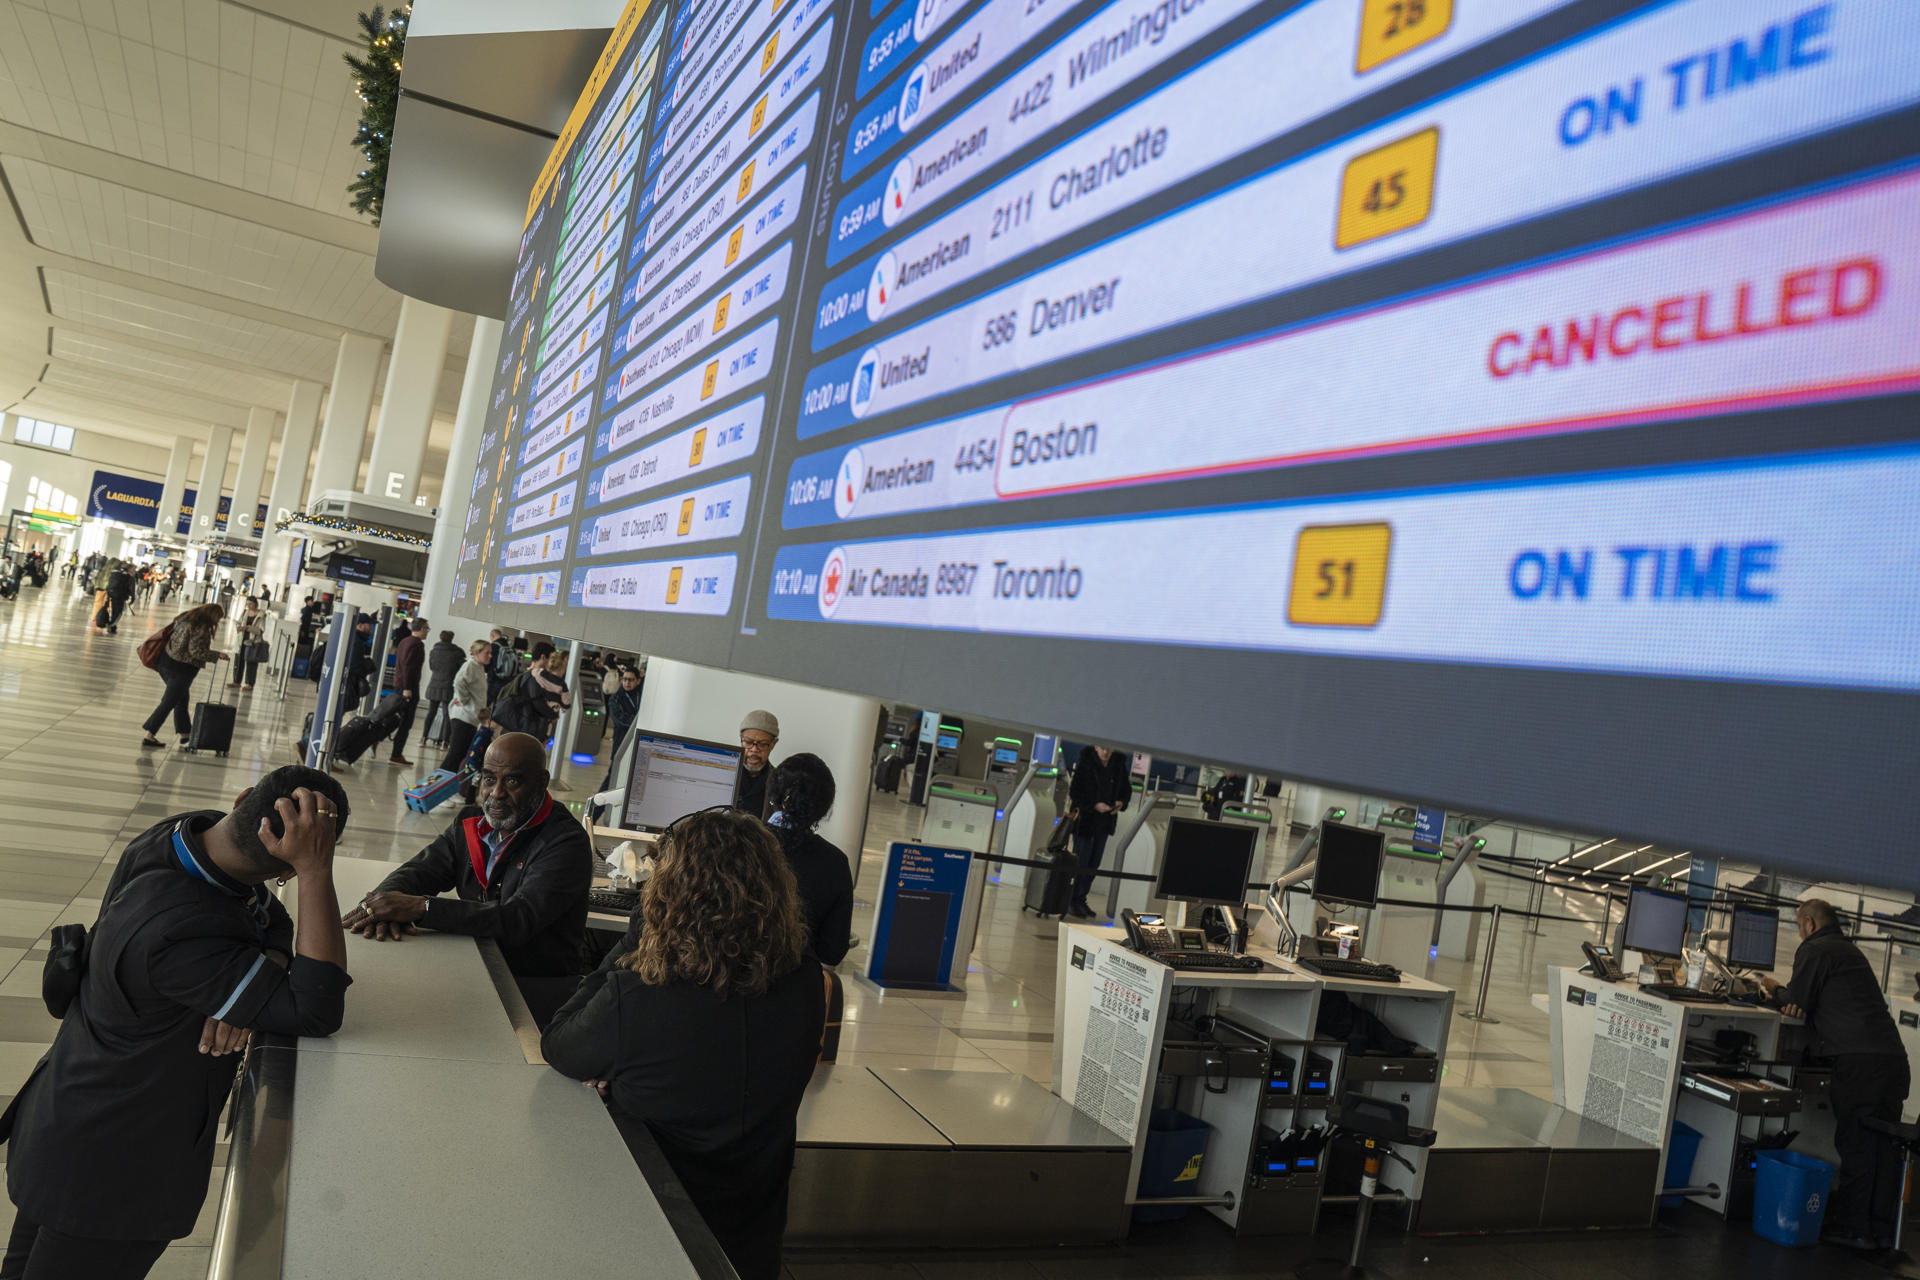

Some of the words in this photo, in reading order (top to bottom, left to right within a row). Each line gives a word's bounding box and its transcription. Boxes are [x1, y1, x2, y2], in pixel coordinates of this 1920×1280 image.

[838, 204, 864, 241] 9:59
[864, 197, 881, 226] AM
[912, 125, 988, 193] American
[1008, 73, 1054, 124] 4422
[1068, 0, 1200, 89] Wilmingto
[853, 116, 880, 155] 9:55
[878, 105, 897, 135] AM
[928, 32, 982, 94] United
[652, 201, 675, 236] American
[691, 161, 711, 196] Dallas
[709, 137, 732, 179] (DFW)
[779, 73, 792, 101] ON
[791, 52, 811, 88] TIME
[661, 149, 685, 188] American
[710, 95, 729, 130] Louis
[643, 255, 665, 286] American
[680, 213, 706, 255] Chicago
[704, 193, 726, 231] (ORD)
[767, 144, 780, 170] ON
[778, 125, 798, 159] TIME
[804, 384, 834, 417] 10:00
[832, 382, 850, 405] AM
[880, 345, 930, 389] United
[1029, 278, 1121, 337] Denver
[1360, 171, 1410, 216] 45
[1558, 79, 1644, 149] ON
[1663, 3, 1836, 111] TIME
[818, 296, 850, 330] 10:00
[848, 288, 865, 313] AM
[896, 233, 971, 290] American
[990, 190, 1034, 241] 2111
[1048, 126, 1169, 210] Charlotte
[634, 308, 655, 336] American
[670, 266, 702, 307] Charleston
[754, 214, 766, 237] ON
[766, 197, 785, 227] TIME
[624, 360, 647, 388] Southwest
[659, 332, 684, 368] Chicago
[682, 317, 705, 352] (MDW)
[741, 286, 754, 308] ON
[753, 272, 771, 300] TIME
[615, 416, 635, 439] American
[650, 391, 675, 420] Nashville
[728, 356, 741, 378] ON
[740, 346, 758, 372] TIME
[789, 476, 818, 506] 10:06
[816, 478, 834, 500] AM
[862, 457, 934, 494] American
[954, 438, 996, 474] 4454
[1010, 422, 1098, 468] Boston
[1486, 255, 1883, 381] CANCELLED
[106, 490, 154, 508] LAGUARDIA
[385, 472, 405, 498] E
[606, 470, 626, 490] American
[639, 455, 658, 478] Detroit
[716, 429, 728, 448] ON
[727, 421, 745, 444] TIME
[164, 516, 174, 526] A
[200, 515, 209, 526] B
[238, 514, 250, 526] C
[277, 508, 290, 524] D
[597, 526, 611, 542] United
[628, 515, 652, 541] Chicago
[649, 511, 669, 536] (ORD)
[681, 510, 690, 526] 44
[704, 504, 715, 522] ON
[714, 500, 731, 520] TIME
[588, 581, 607, 594] American
[619, 577, 638, 595] Buffalo
[692, 578, 702, 594] ON
[701, 576, 718, 594] TIME
[774, 570, 801, 595] 10:10
[800, 574, 818, 594] AM
[847, 572, 868, 598] Air
[870, 568, 929, 598] Canada
[934, 564, 978, 596] 8987
[992, 560, 1083, 600] Toronto
[1315, 559, 1357, 601] 51
[1505, 546, 1593, 604] ON
[1612, 538, 1780, 605] TIME
